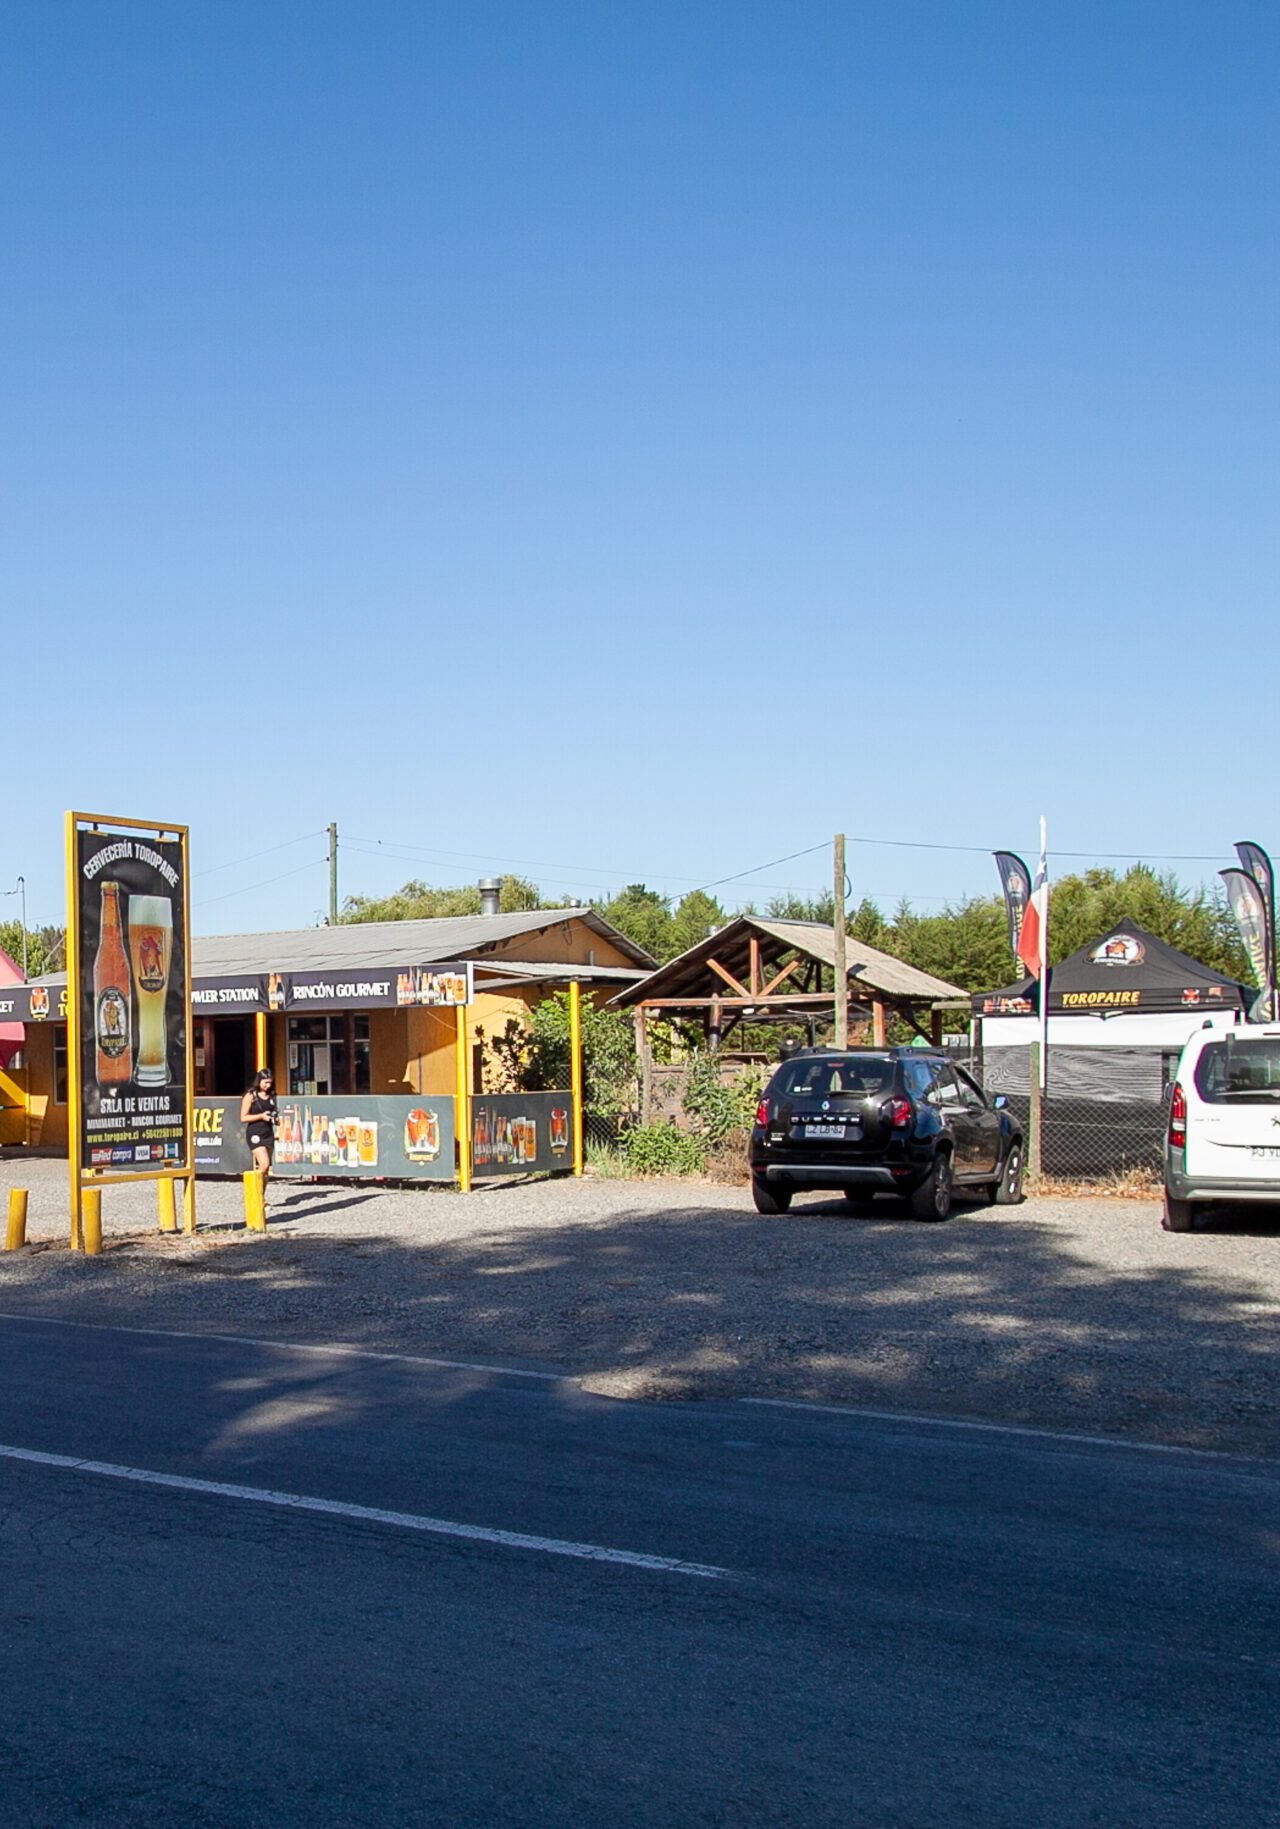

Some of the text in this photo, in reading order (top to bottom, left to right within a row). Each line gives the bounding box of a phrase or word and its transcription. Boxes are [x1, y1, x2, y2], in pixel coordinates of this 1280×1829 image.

[83, 839, 180, 888] CERVECERÍA TOROPAIRE
[219, 988, 259, 1002] STATION
[293, 981, 391, 999] RINCÓN GOURMET
[1061, 991, 1140, 1005] TOROPAIRE
[100, 1096, 170, 1114] SALA DE VENTAS
[86, 1117, 126, 1130] MINIMARKET
[155, 1114, 183, 1126] GOURMET
[136, 1149, 150, 1158] VISA
